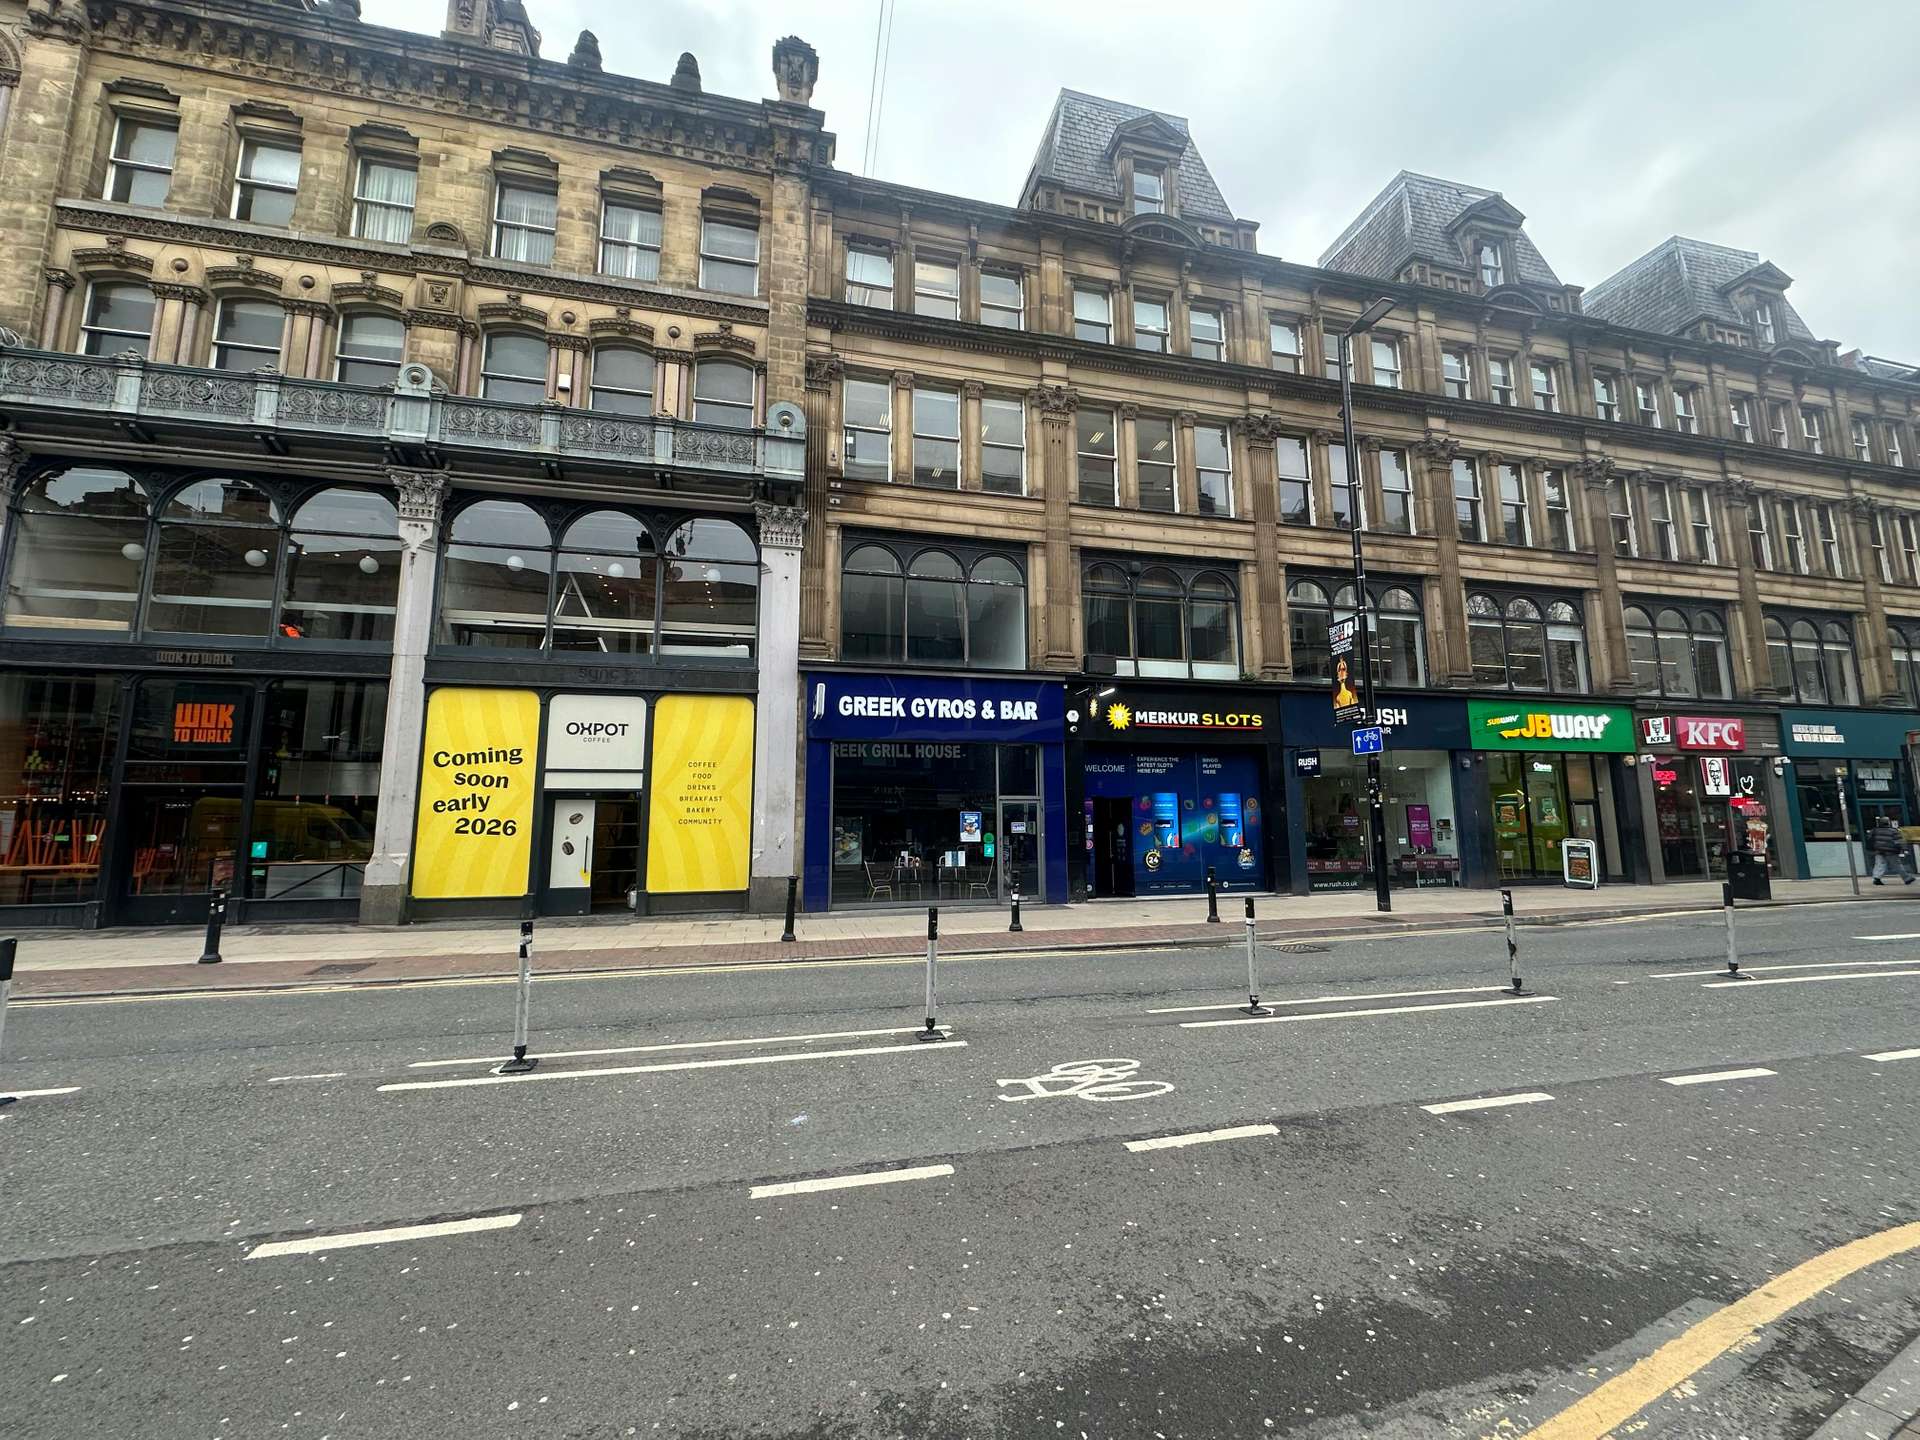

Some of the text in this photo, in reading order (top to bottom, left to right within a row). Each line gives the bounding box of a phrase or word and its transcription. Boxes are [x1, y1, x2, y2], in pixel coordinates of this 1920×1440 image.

[157, 651, 233, 665] WOK TO WALK
[175, 703, 235, 728] WOK
[838, 696, 1038, 720] GREEK GYROS & BAR
[1135, 711, 1263, 726] MERKUR SLOTS
[1486, 715, 1519, 726] SUBWAY
[174, 728, 232, 743] TO WALK
[566, 722, 629, 736] OXPOT
[1686, 721, 1739, 746] KFC
[433, 747, 523, 768] Coming
[834, 743, 961, 758] REEK GRILL HOUSE
[1085, 764, 1125, 773] WELCOME
[1298, 757, 1317, 767] RUSH
[454, 772, 509, 788] soon
[432, 793, 491, 813] early
[454, 817, 517, 836] 2026
[1313, 880, 1358, 889] www.rush.co.uk
